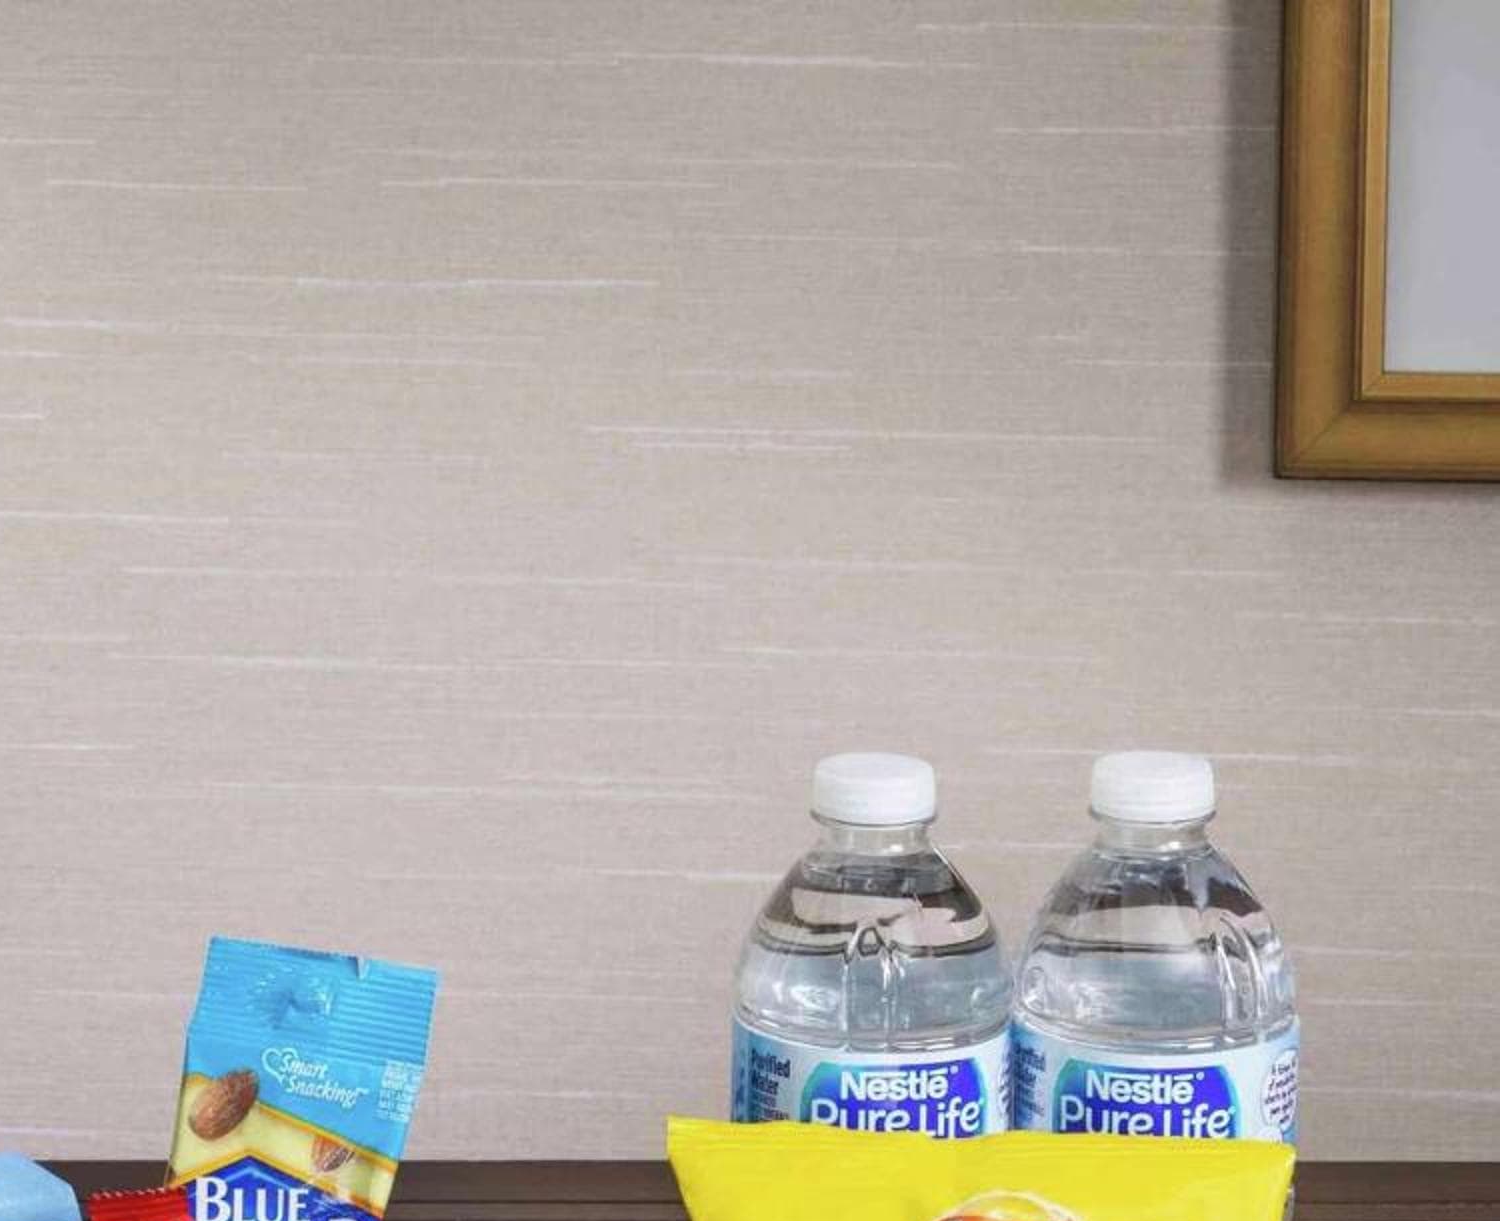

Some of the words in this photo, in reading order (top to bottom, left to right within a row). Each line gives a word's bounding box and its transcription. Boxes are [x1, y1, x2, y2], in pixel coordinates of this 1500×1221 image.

[811, 1098, 911, 1133] Pure
[918, 1096, 984, 1139] Life
[1060, 1095, 1153, 1135] Pure
[1163, 1104, 1232, 1138] Life
